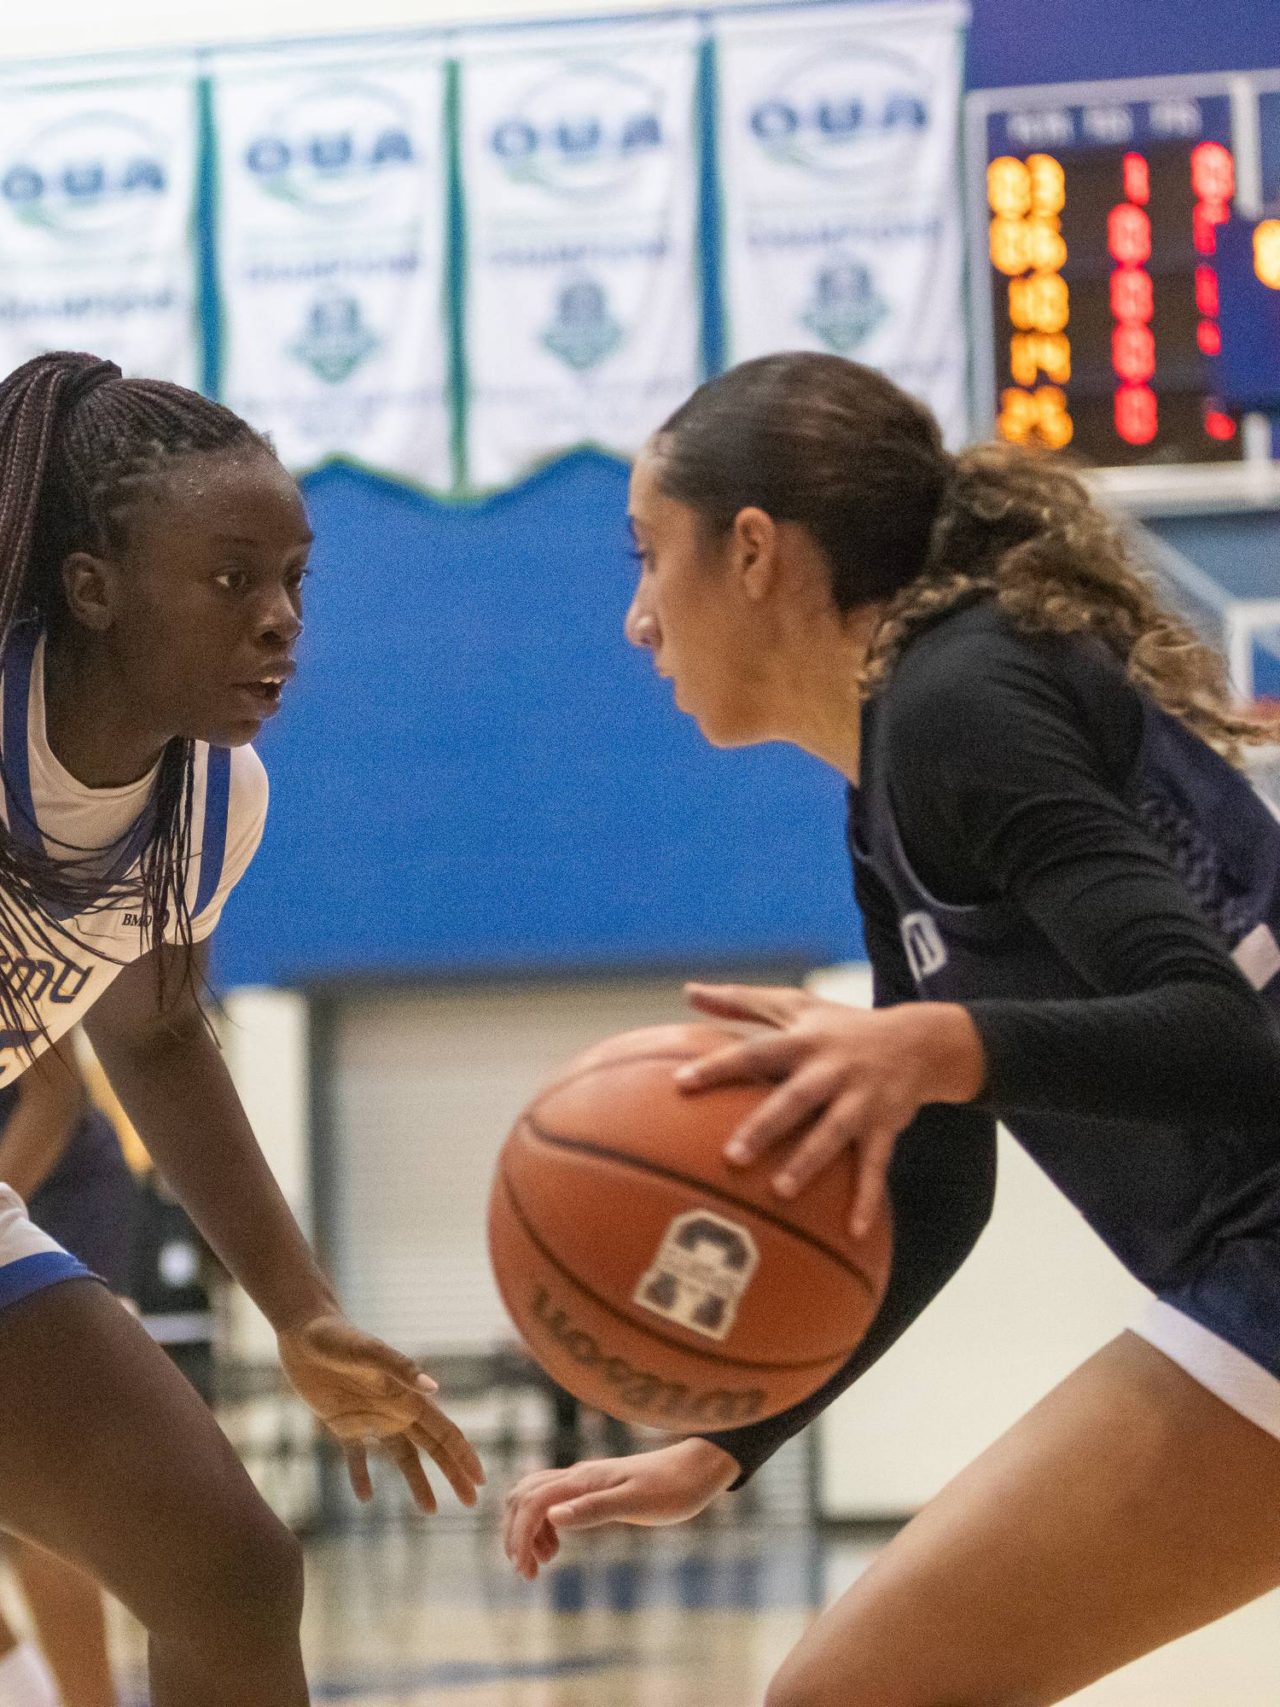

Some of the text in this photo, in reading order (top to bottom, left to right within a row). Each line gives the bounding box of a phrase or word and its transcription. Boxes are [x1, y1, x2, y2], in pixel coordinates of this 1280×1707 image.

[490, 114, 663, 160] OUA
[750, 95, 929, 142] OUA
[243, 128, 415, 177] OUA
[0, 158, 166, 204] OUA
